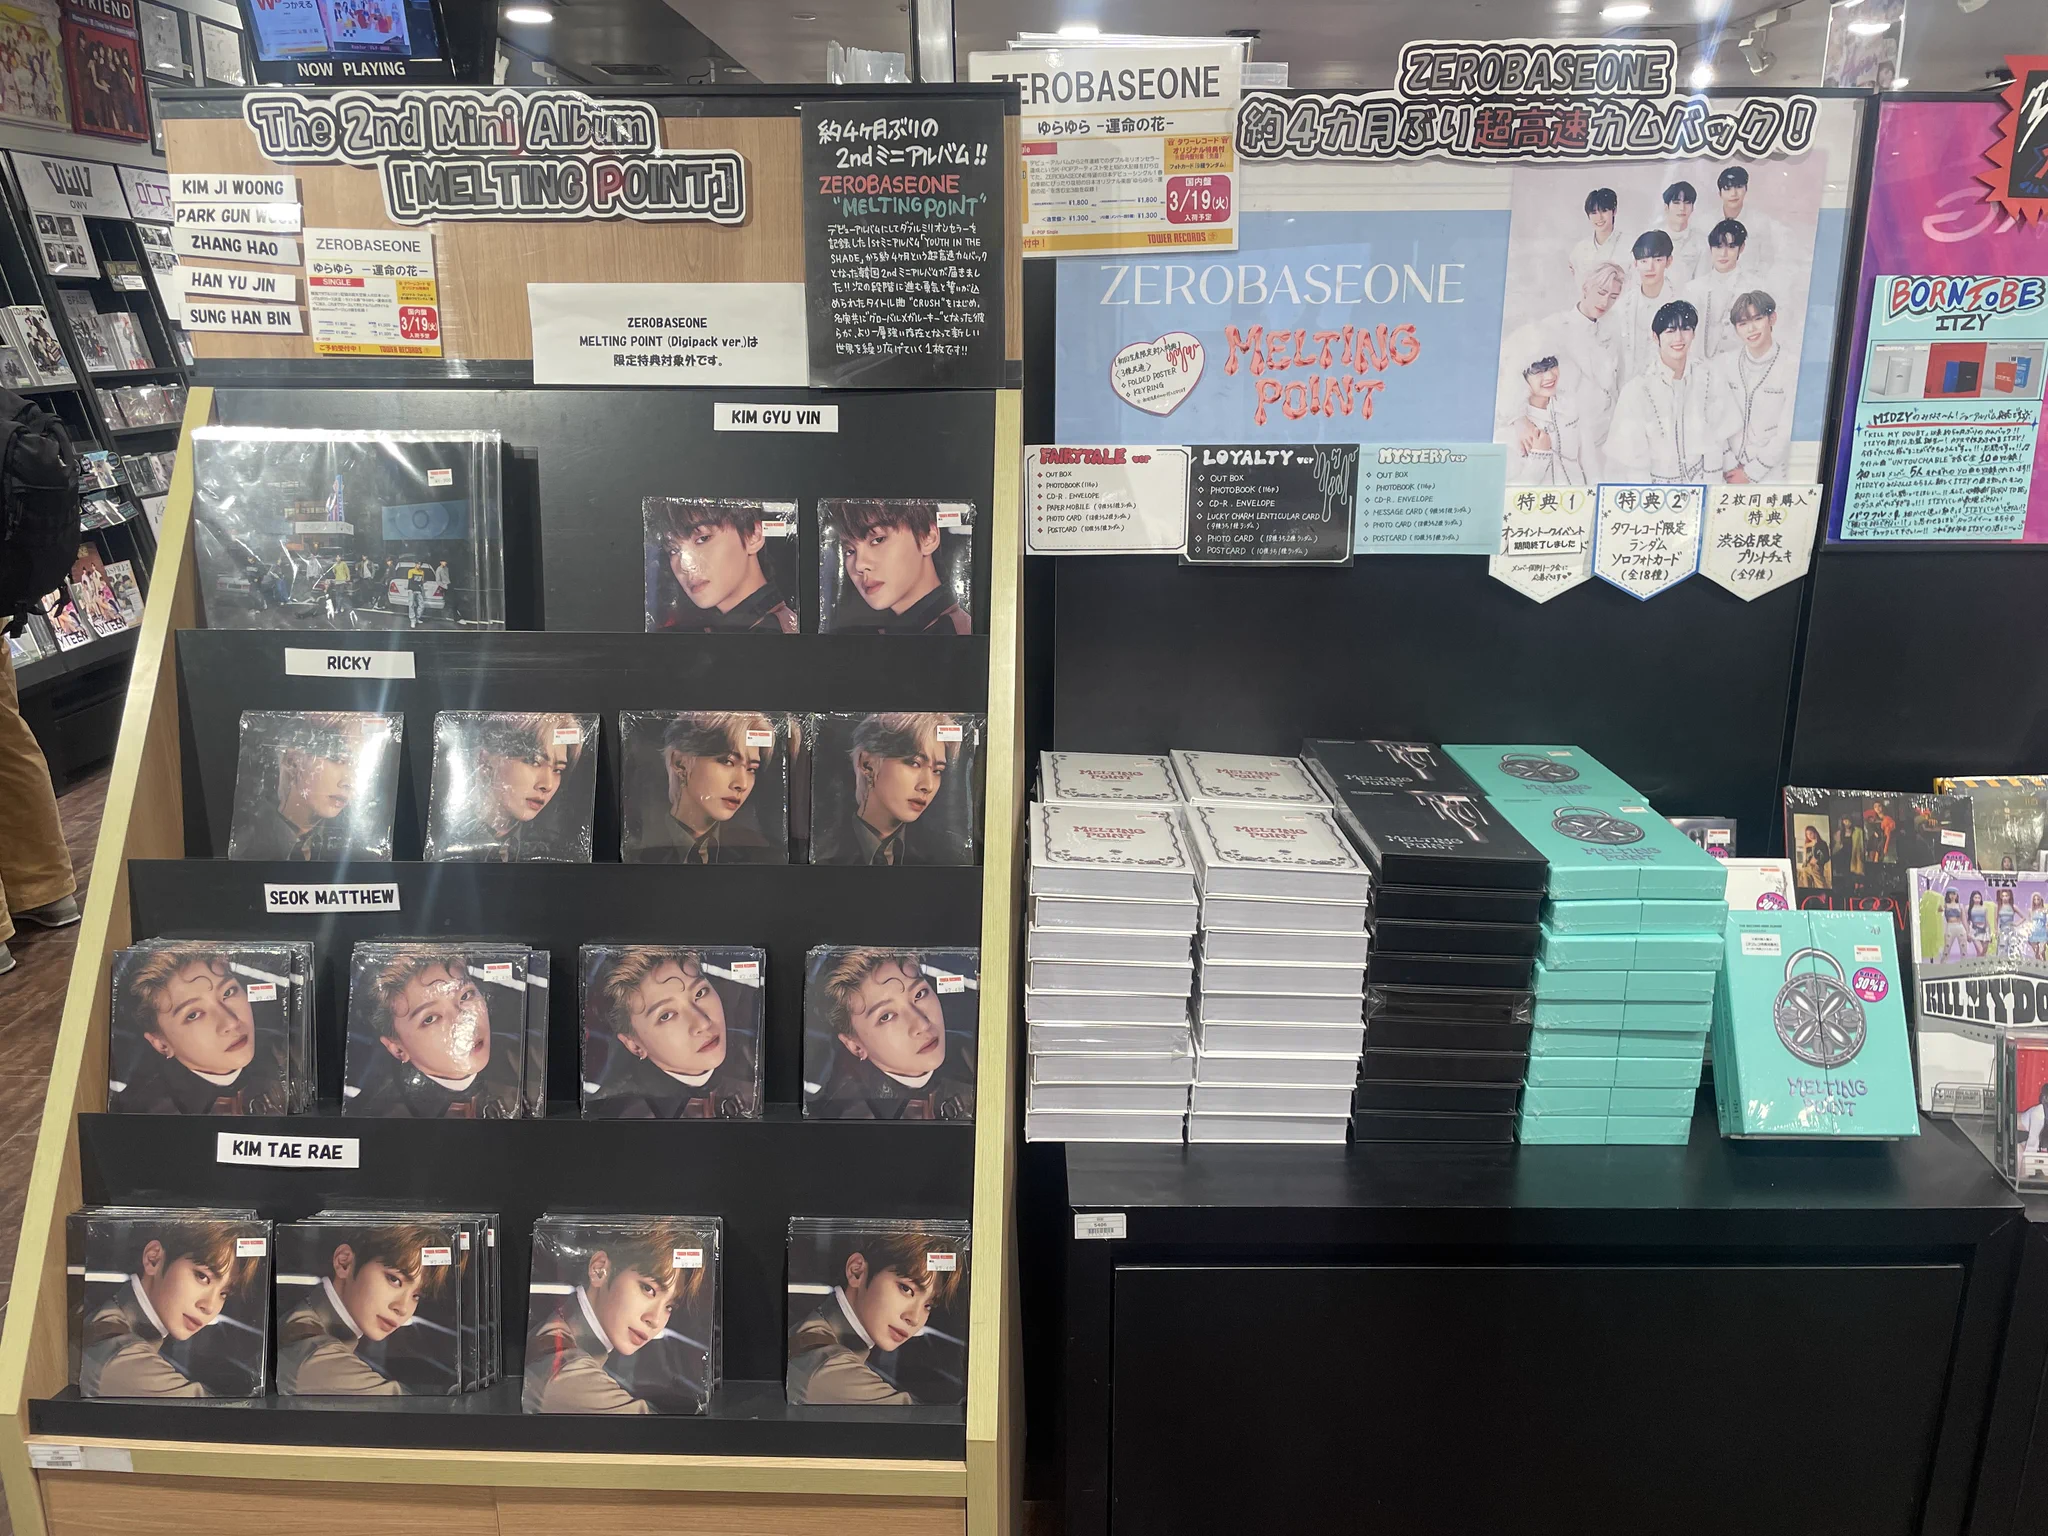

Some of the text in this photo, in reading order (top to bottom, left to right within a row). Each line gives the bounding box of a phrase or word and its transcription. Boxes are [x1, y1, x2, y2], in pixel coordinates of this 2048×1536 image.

[297, 62, 406, 77] NOW PLAYING
[1408, 51, 1670, 92] ZEROBASEONE
[991, 65, 1220, 105] EROBASEONE
[254, 101, 648, 151] The 2nd Mini Album
[1037, 119, 1092, 136] ゆらゆら
[1177, 138, 1219, 146] タワーレコード
[182, 180, 284, 195] KIM JI WOONG
[819, 174, 961, 195] ZEROBASEONE
[1185, 177, 1212, 187] 国内盤
[70, 200, 89, 210] OWV
[176, 208, 216, 223] PARK
[221, 208, 250, 223] GUN
[1184, 213, 1213, 222] 入荷予定
[190, 234, 279, 256] ZHANG HAO
[315, 238, 422, 253] ZEROBASEONE
[965, 238, 982, 248] THE
[1147, 232, 1206, 244] TOWER RECORDS
[313, 262, 354, 275] ゆらゆら
[191, 272, 276, 293] HAN YU JIN
[322, 278, 352, 287] SINGLE
[1099, 263, 1466, 305] ZEROBASEONE
[1892, 279, 1969, 312] BORN
[190, 309, 292, 326] SUNG HAN BIN
[626, 317, 708, 329] ZEROBASEONE
[1935, 313, 1993, 331] ITZY
[579, 335, 628, 347] MELTING
[630, 335, 663, 347] POINT
[667, 335, 718, 348] (Digipack
[379, 345, 423, 354] TOWER RECORDS
[1224, 323, 1421, 377] MELTING
[613, 354, 724, 367] 限定特典対象外です。
[1127, 366, 1178, 388] FOLDED POSTER
[1133, 381, 1165, 397] KEYRING
[1253, 374, 1386, 427] POINT
[731, 410, 821, 425] KIM GYU VIN
[1039, 447, 1127, 465] FAIRYTALE
[1202, 449, 1315, 466] LOYALTY ver
[1378, 447, 1468, 464] MYSTERY ver
[1209, 474, 1245, 483] OUT BOX
[1376, 471, 1409, 479] OUT BOX
[1210, 486, 1256, 495] PHOTOBOOK
[1375, 483, 1415, 492] PHOTOBOOK
[1069, 492, 1100, 500] ENVELOPE
[1236, 499, 1276, 508] ENVELOPE
[1397, 495, 1434, 503] ENVELOPE
[1719, 492, 1808, 507] 2枚同時購入
[1046, 503, 1090, 512] PAPER MOBILE
[1372, 507, 1424, 516] MESSAGE CARD
[1066, 514, 1082, 522] CARD
[1206, 512, 1321, 521] LUCKY CHARM LENTICULAR CARD
[1747, 510, 1783, 526] 特典
[1047, 526, 1078, 534] POSTCARD
[1372, 520, 1412, 529] PHOTO CARD
[1610, 520, 1688, 536] タワーレコード限定
[1206, 534, 1254, 543] PHOTO CARD
[1372, 534, 1408, 543] POSTCARD
[1513, 539, 1576, 551] 期間終了しました
[1629, 537, 1668, 551] ランダム
[1716, 532, 1784, 549] 渋谷店限定
[1206, 546, 1247, 556] POSTCARD
[1736, 550, 1793, 565] プリントチェキ
[1611, 551, 1683, 567] ソロフォトカード
[326, 655, 372, 671] RICKY
[269, 888, 395, 906] SEOK MATTHEW
[1787, 1077, 1869, 1098] MELTING
[1802, 1098, 1857, 1117] POINT
[232, 1139, 343, 1160] KIM TAE RAE
